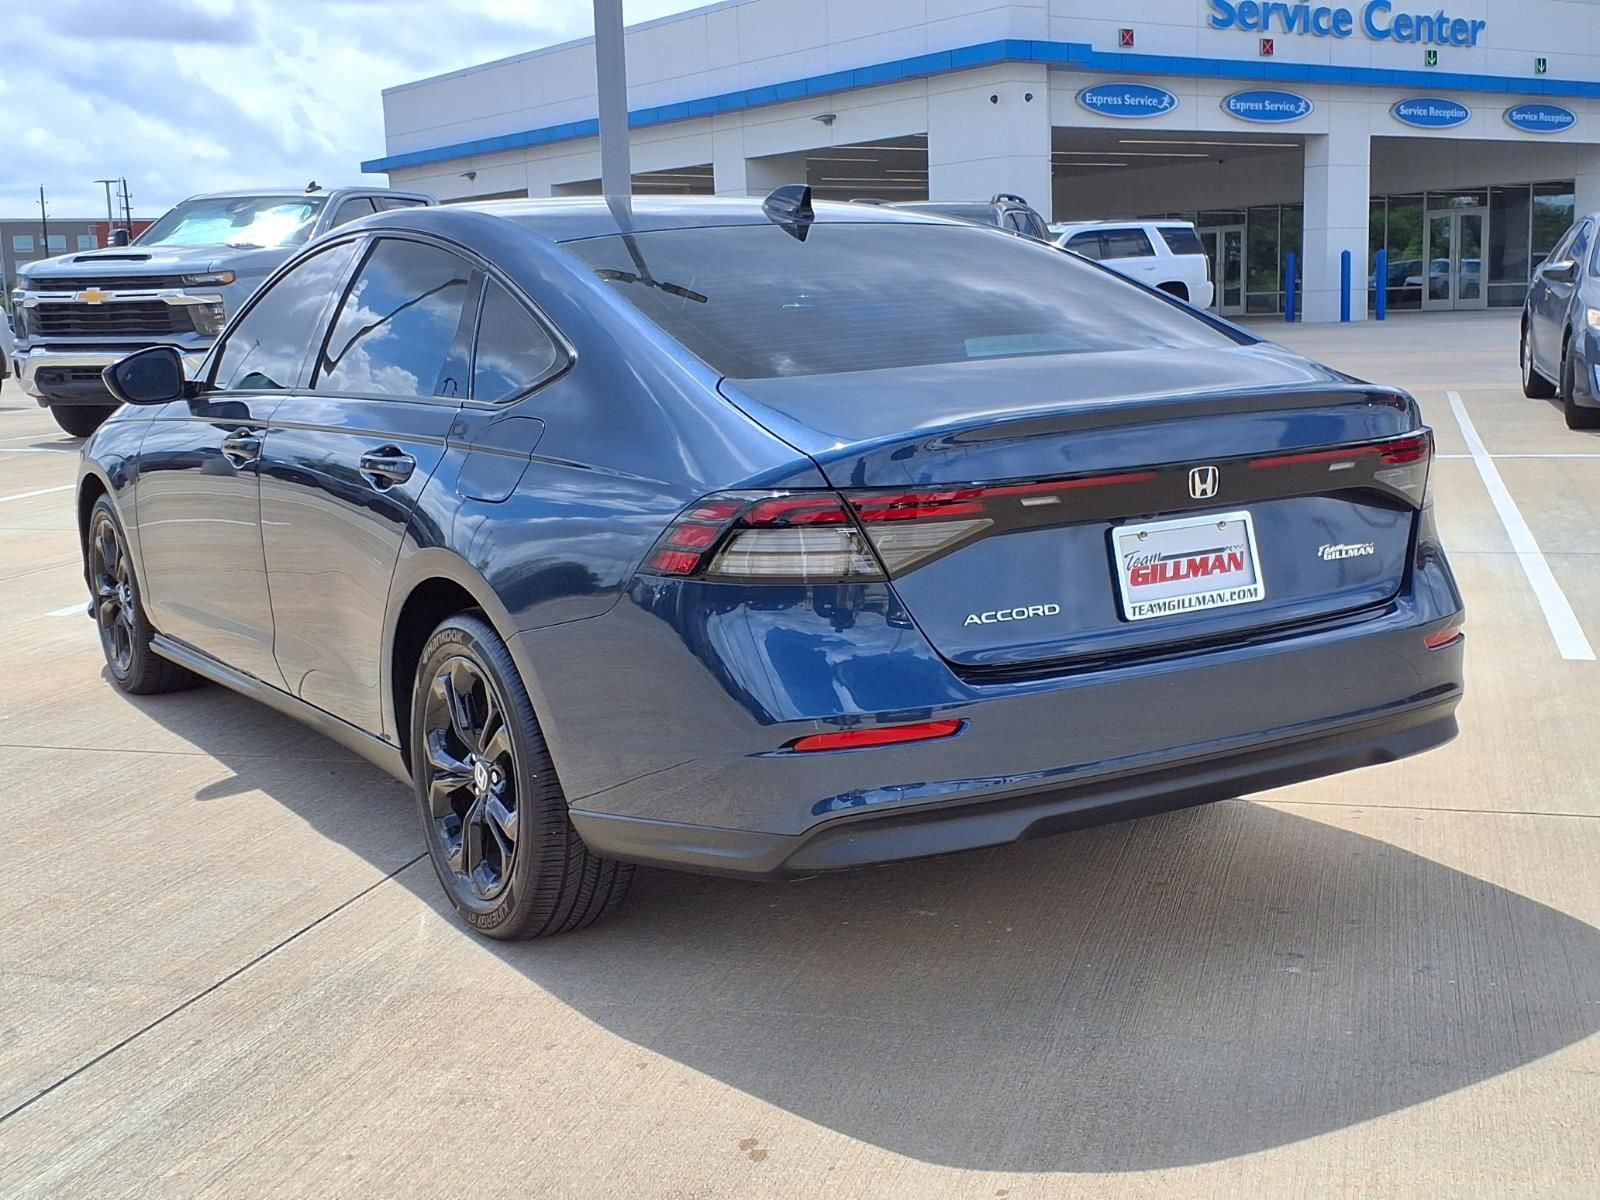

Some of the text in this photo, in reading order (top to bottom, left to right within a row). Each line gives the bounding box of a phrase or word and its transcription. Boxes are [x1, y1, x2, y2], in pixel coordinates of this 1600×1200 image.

[1209, 0, 1486, 47] Service Center
[1085, 92, 1159, 106] Express Service
[1230, 99, 1296, 112] Express Service
[1399, 105, 1466, 119] Service Reception
[1512, 111, 1573, 124] Service Reception
[1124, 550, 1161, 571] Team
[1323, 545, 1375, 561] GILLMAN
[1130, 551, 1244, 587] GILLMAN
[1130, 587, 1258, 617] TEAMGILLMAN.COM
[963, 603, 1060, 627] ACCORD
